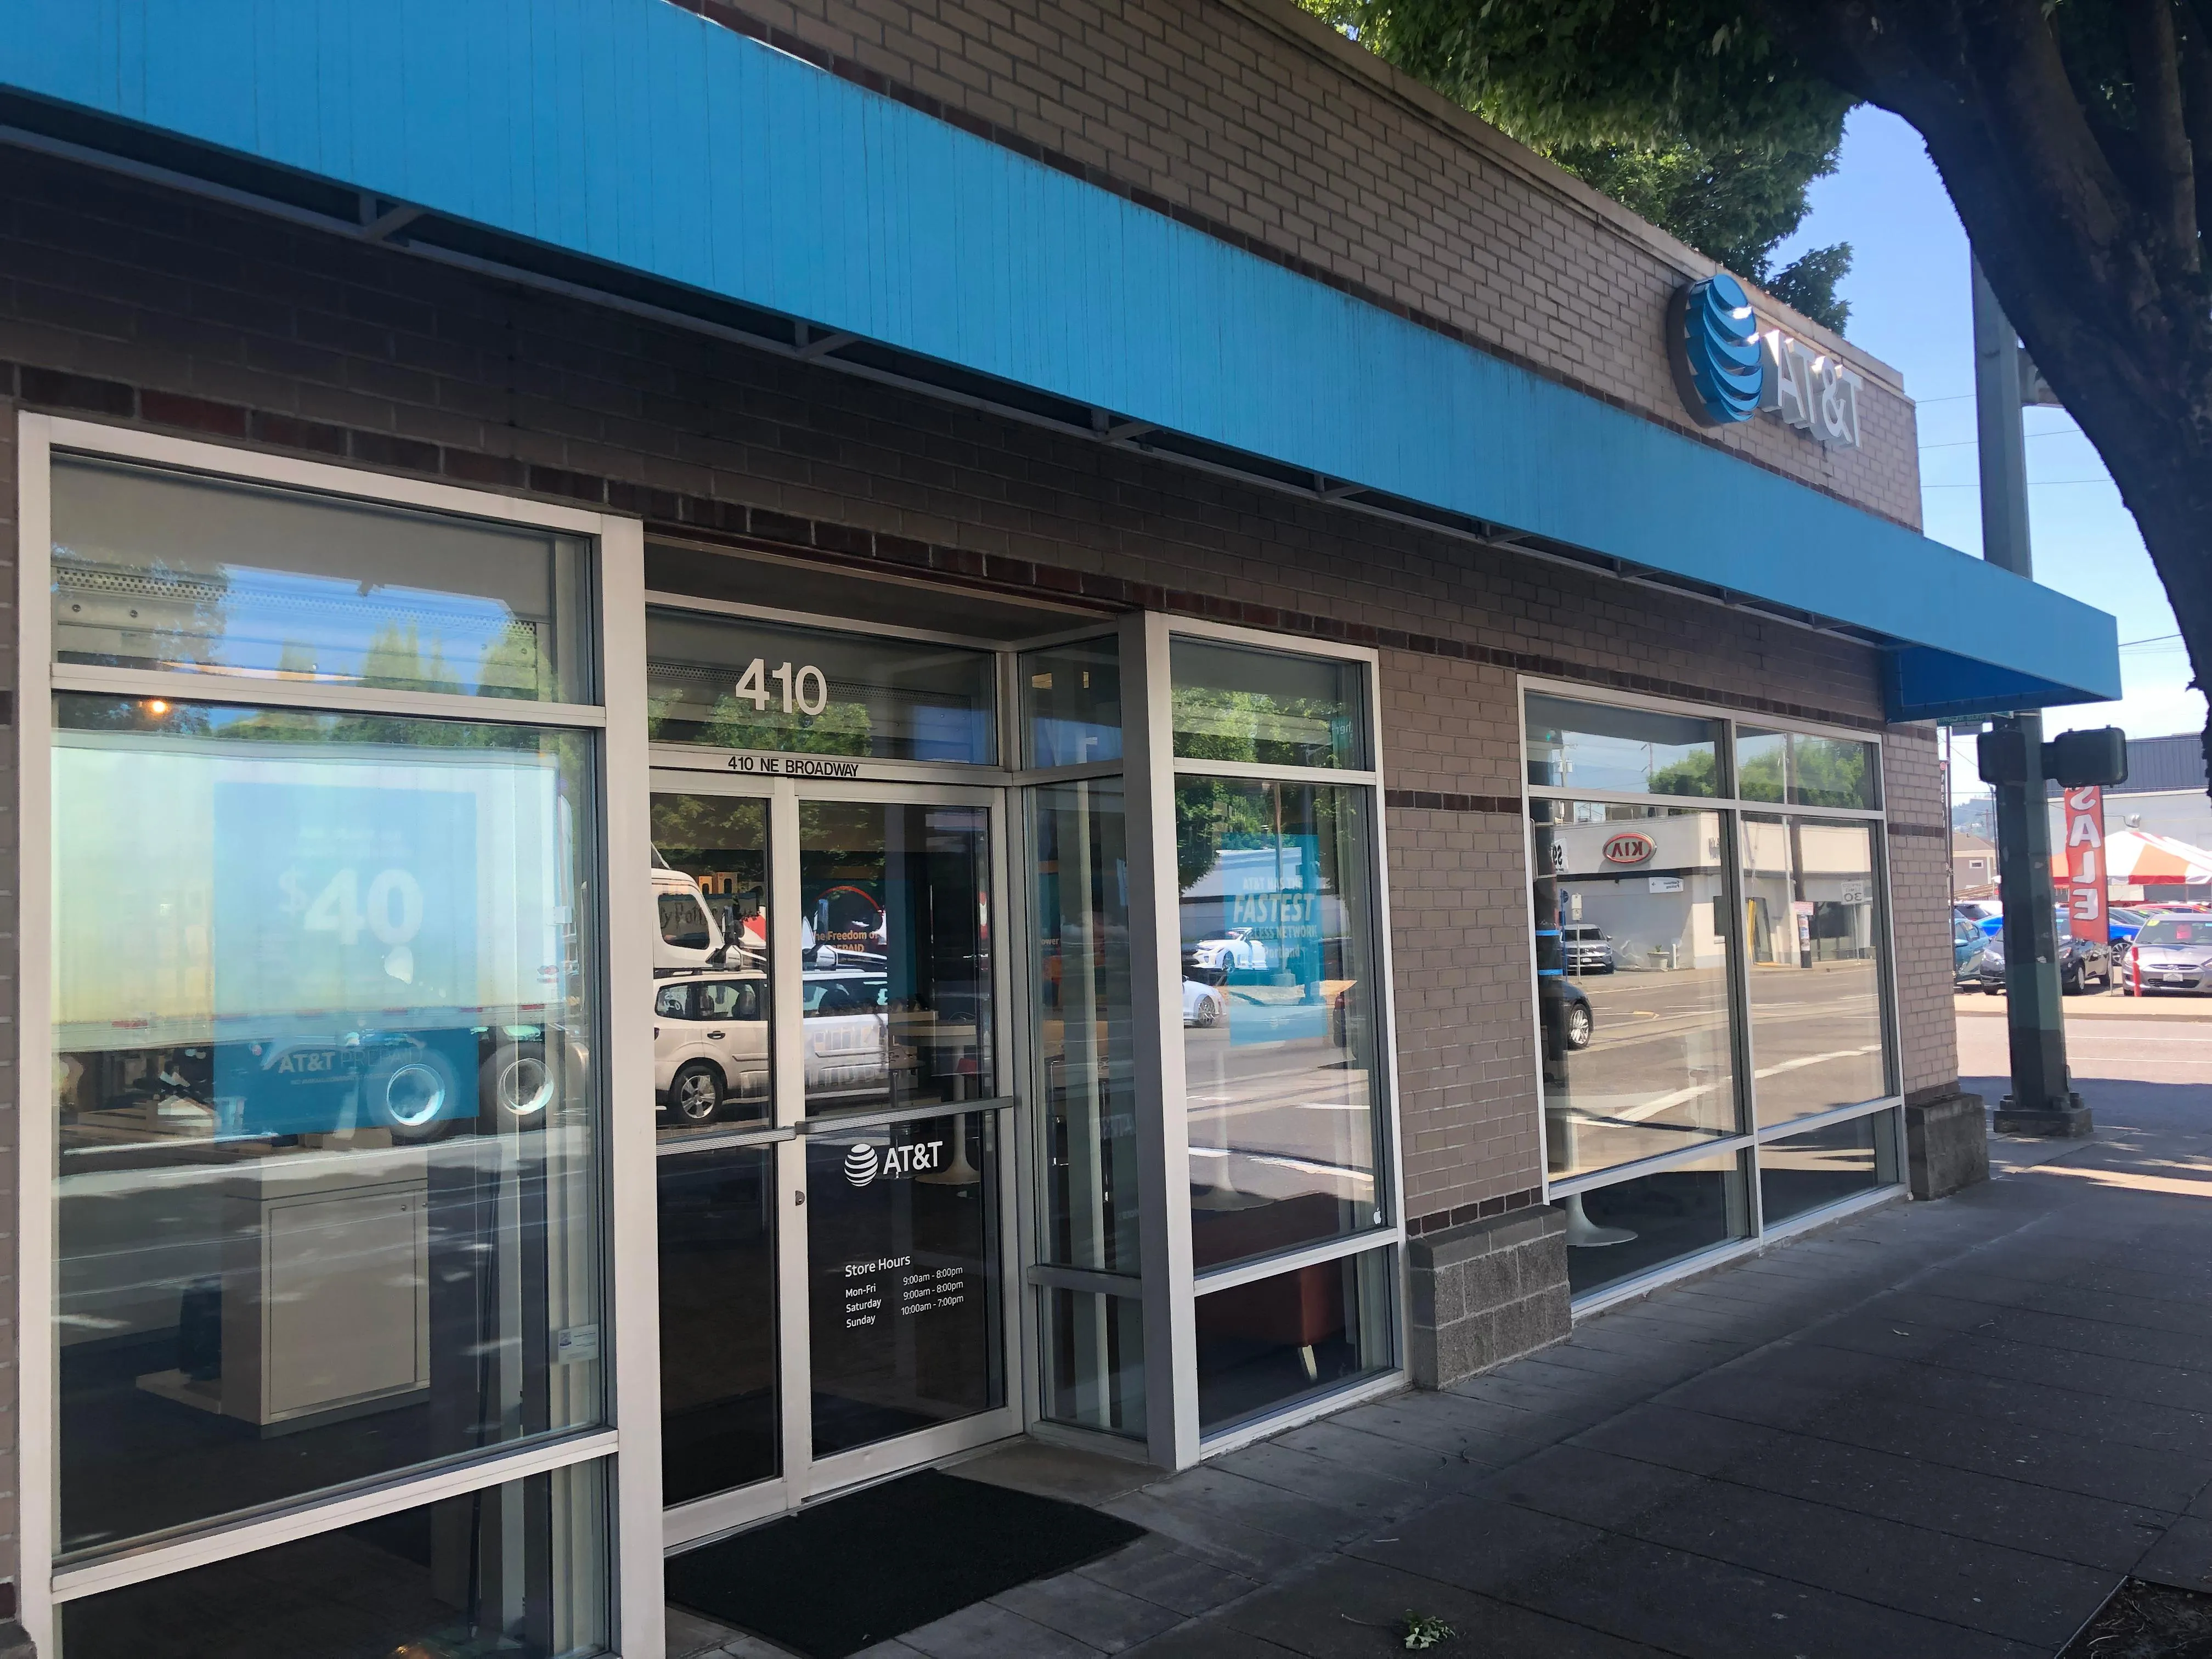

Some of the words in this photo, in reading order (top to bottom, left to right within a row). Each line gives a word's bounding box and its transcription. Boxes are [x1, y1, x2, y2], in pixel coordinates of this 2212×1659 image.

[1764, 329, 1864, 447] AT&T
[736, 658, 827, 715] 410
[728, 756, 754, 770] 410
[760, 758, 779, 772] NE
[786, 760, 859, 777] BROADWAY
[1243, 878, 1265, 890] AT&T
[278, 864, 424, 945] $40
[1233, 893, 1314, 923] FASTEST
[828, 930, 867, 940] Freedom
[1041, 937, 1059, 945] ower
[1277, 924, 1317, 939] NETWORK
[278, 1051, 336, 1073] AT&T
[883, 1141, 943, 1175] AT&T
[845, 1263, 876, 1277] Store
[878, 1256, 911, 1271] Hours
[902, 1273, 930, 1286] 9:00am
[936, 1266, 963, 1278] 8:00pm
[845, 1283, 876, 1298] Mon-Fri
[903, 1288, 930, 1301] 9:00am
[936, 1281, 963, 1293] 8:00pm
[846, 1298, 882, 1313] Saturday
[900, 1302, 932, 1316] 10:00am
[937, 1295, 964, 1308] 7:00pm
[847, 1314, 876, 1328] Sunday
